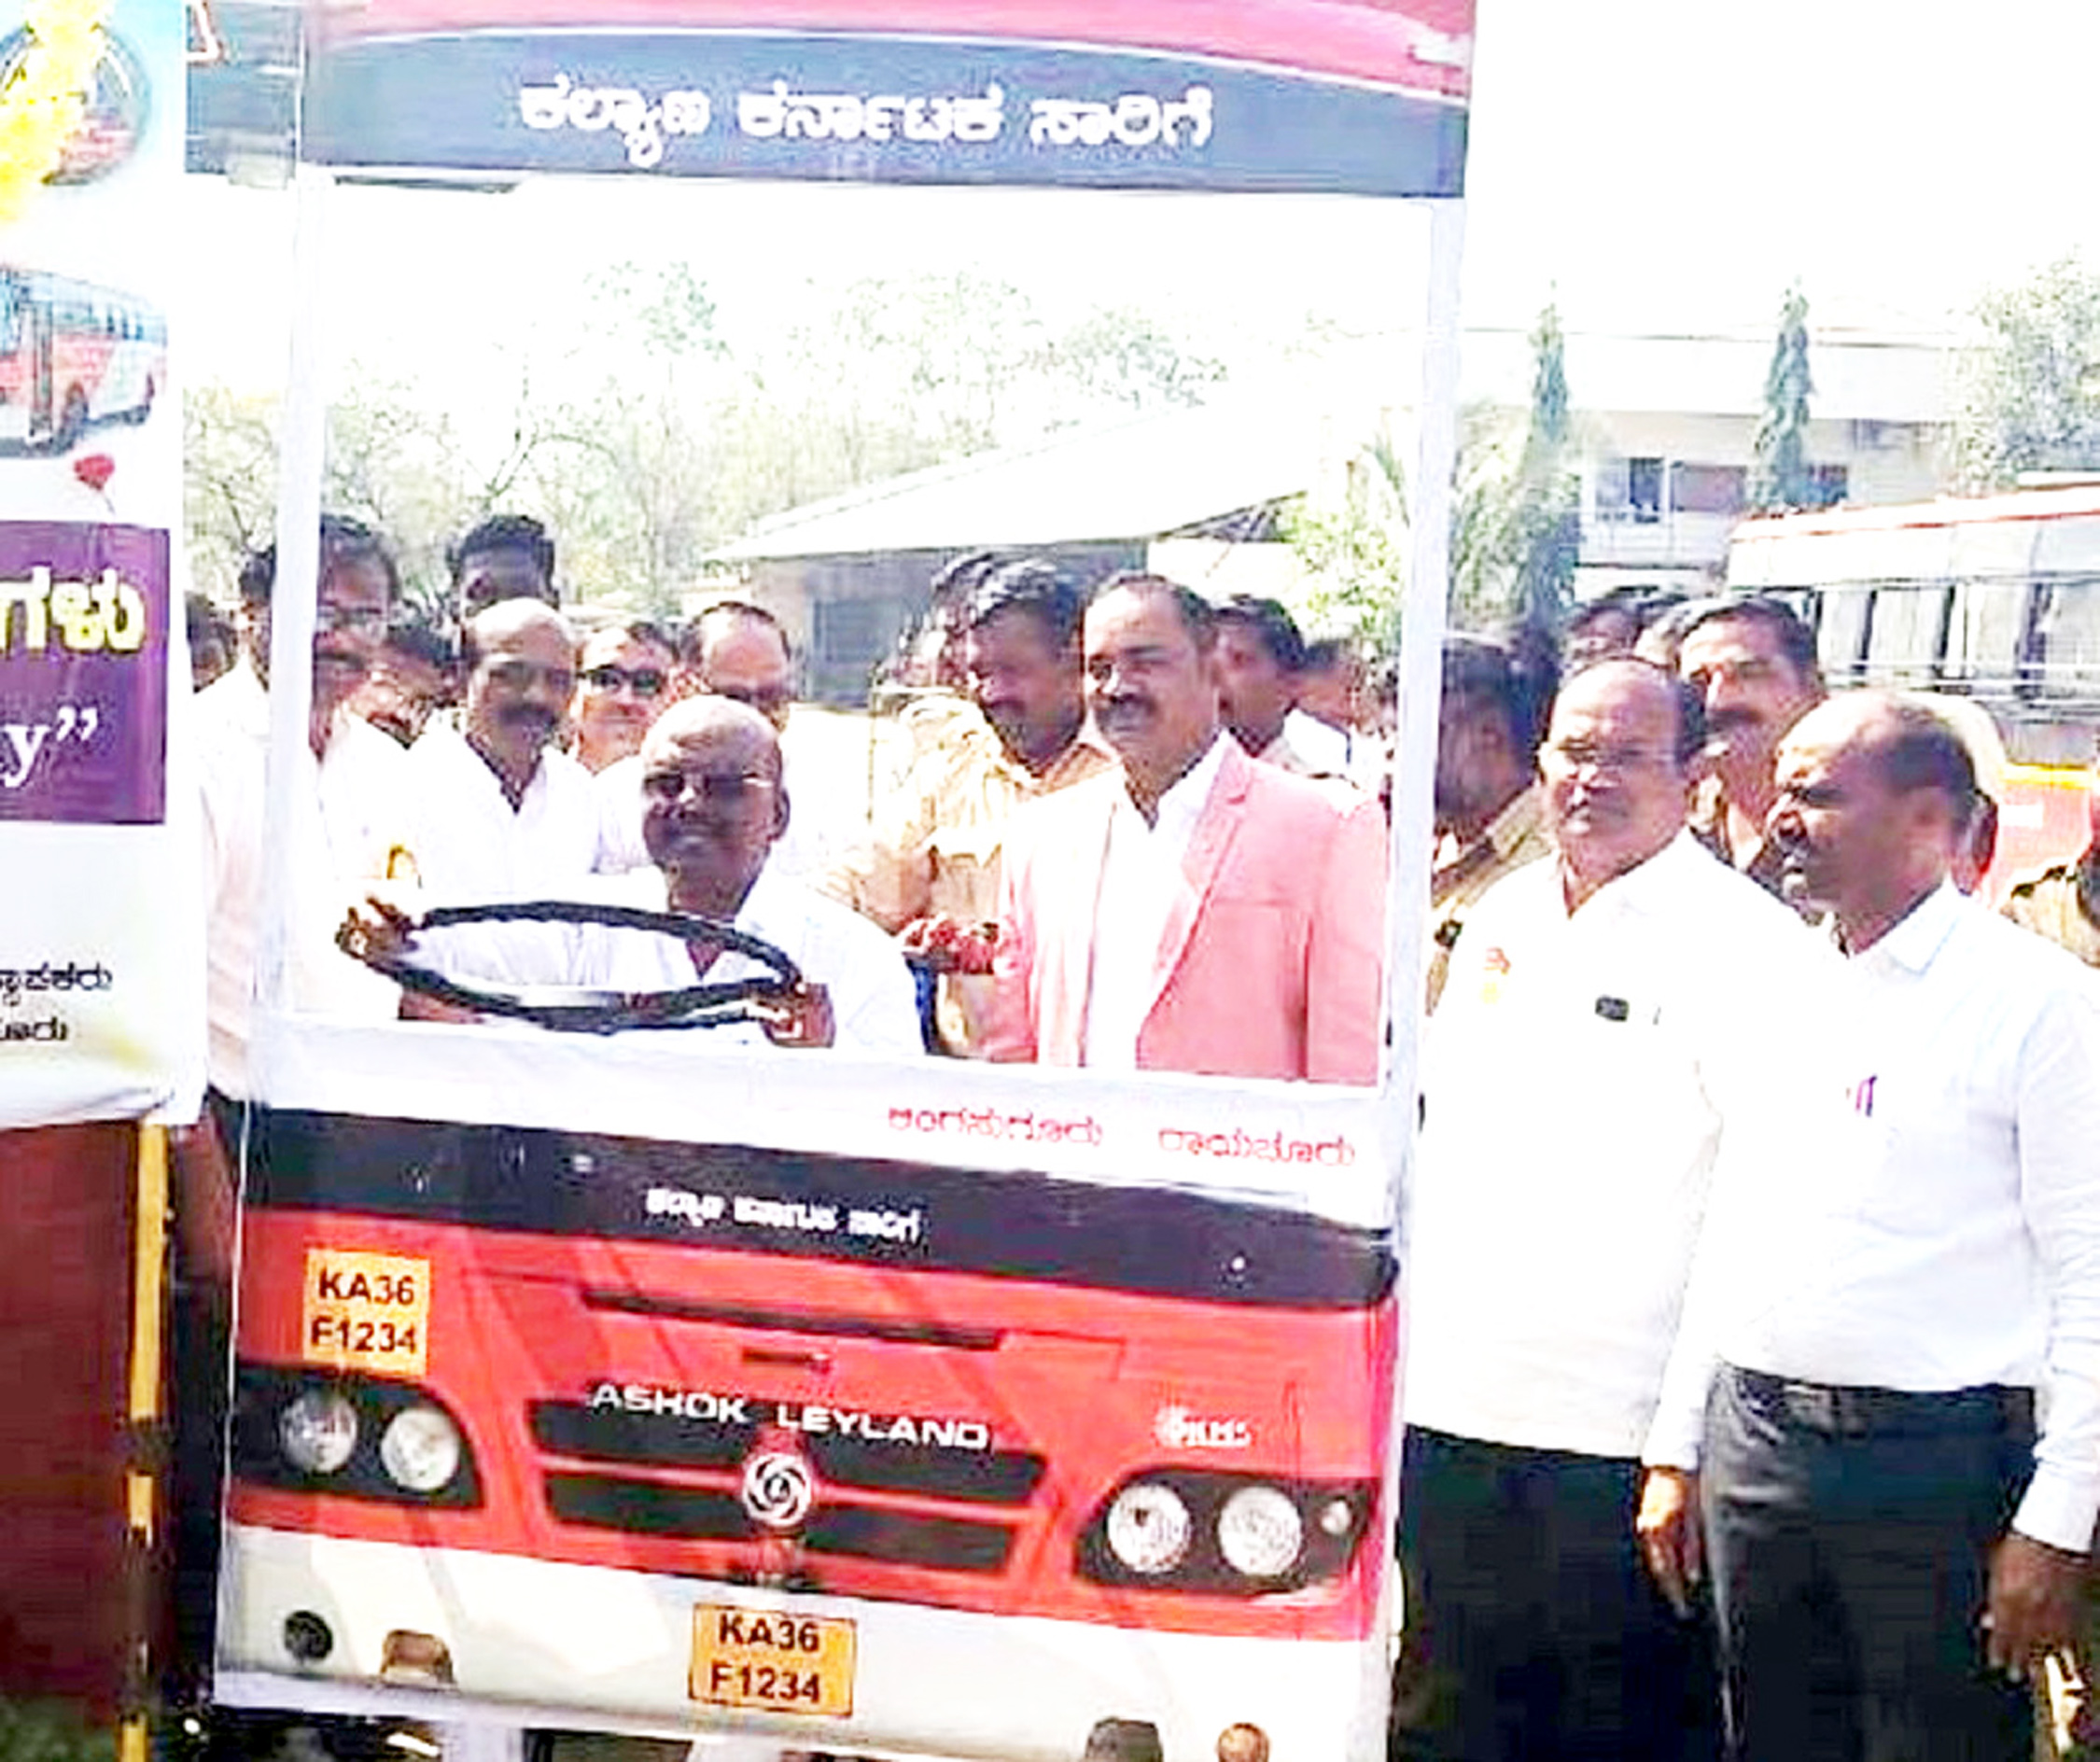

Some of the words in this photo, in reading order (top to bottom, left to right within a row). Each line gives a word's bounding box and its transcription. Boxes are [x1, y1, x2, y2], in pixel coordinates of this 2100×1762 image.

[521, 74, 711, 168] ಕಲ್ಯಾಣ
[738, 79, 1003, 141] ಕರ್ನಾಟಕ
[1029, 85, 1212, 147] ಸಾರಿಗೆ
[318, 1266, 414, 1306] KA36
[311, 1314, 416, 1354] F1234
[591, 1383, 748, 1423] ASHOK
[777, 1405, 988, 1449] LEYLAND
[719, 1613, 820, 1653] KA36
[710, 1658, 820, 1704] F1234
